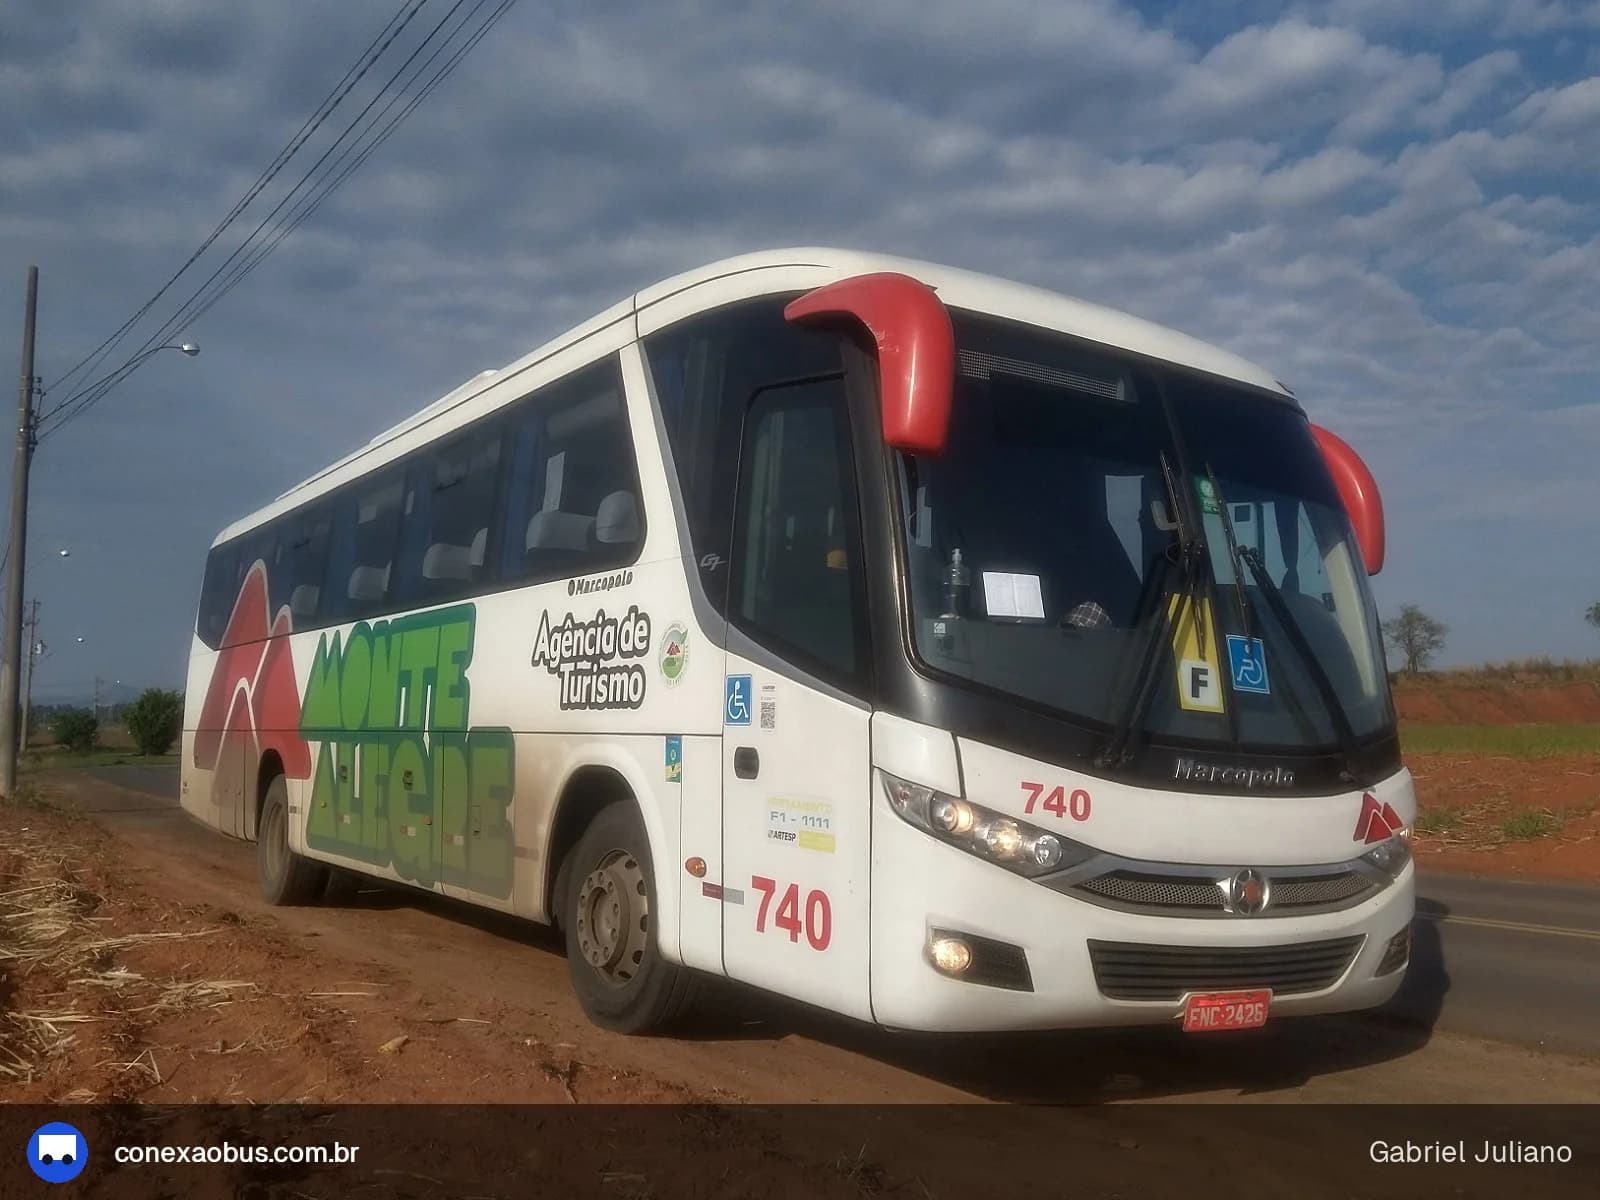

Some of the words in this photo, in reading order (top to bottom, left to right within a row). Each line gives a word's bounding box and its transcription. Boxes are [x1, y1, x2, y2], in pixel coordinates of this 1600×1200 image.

[576, 570, 633, 595] Marcopolo
[532, 609, 618, 673] Agência
[618, 605, 650, 658] de
[301, 604, 477, 733] MONTE
[559, 662, 646, 710] Turismo
[1191, 667, 1208, 698] F
[1175, 759, 1295, 788] Marcopolo
[306, 728, 516, 900] ALEGRE
[770, 811, 785, 822] F1
[802, 815, 830, 829] 1111
[1021, 781, 1091, 821] 740
[773, 830, 796, 842] ARTESP
[752, 875, 832, 951] 740
